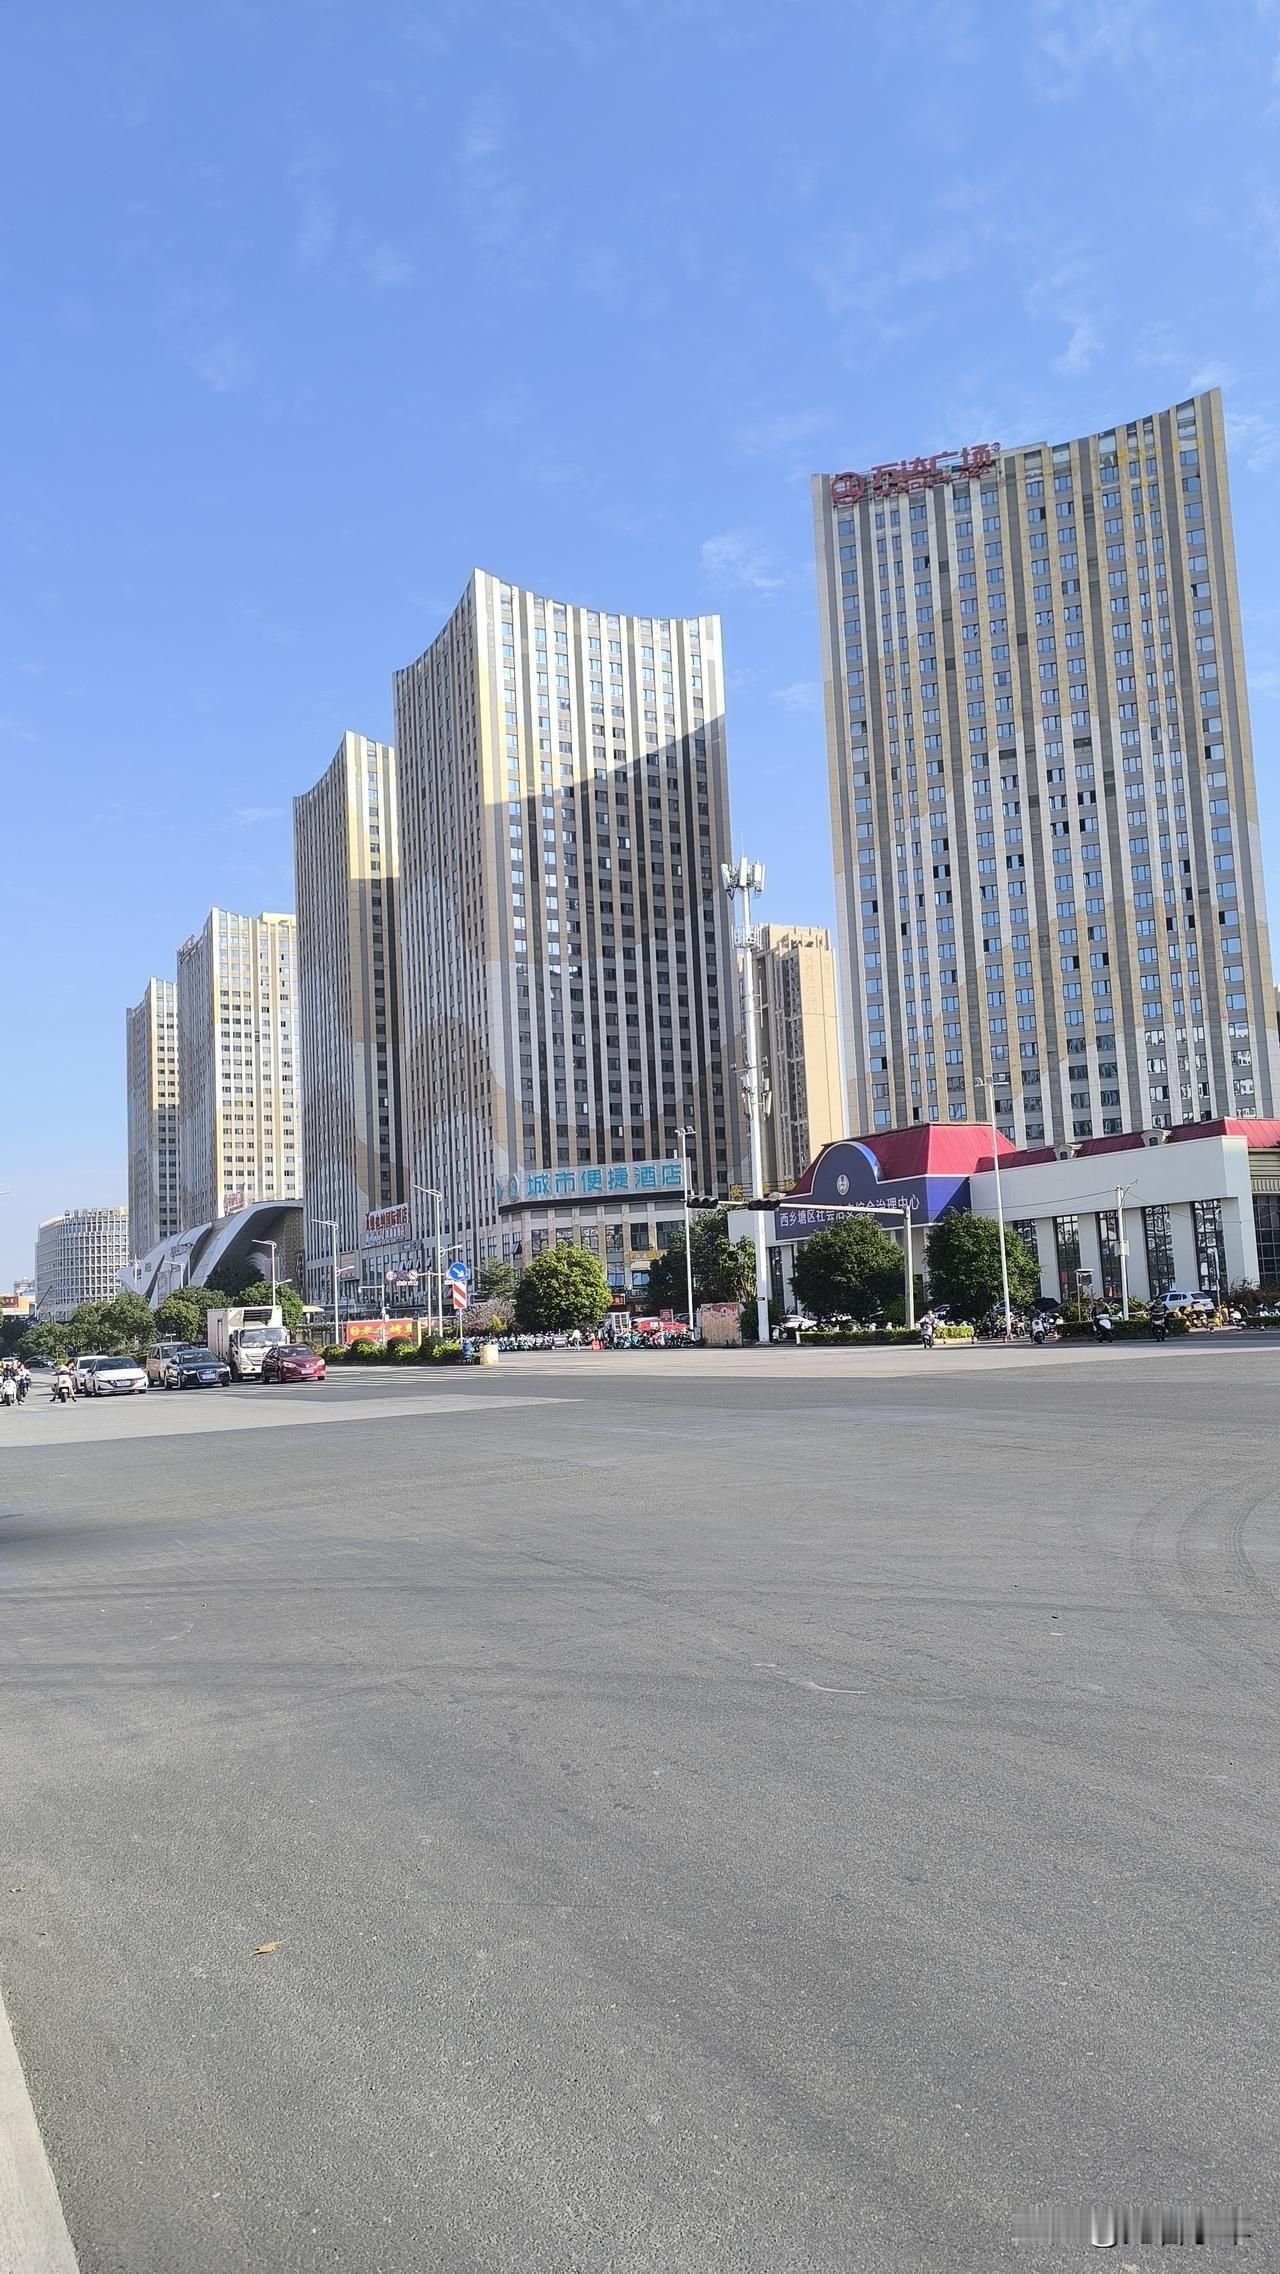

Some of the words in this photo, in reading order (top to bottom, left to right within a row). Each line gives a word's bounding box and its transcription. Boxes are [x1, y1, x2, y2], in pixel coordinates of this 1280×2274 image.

[871, 443, 992, 486] 万达广场
[526, 1163, 683, 1196] 城市便捷酒店
